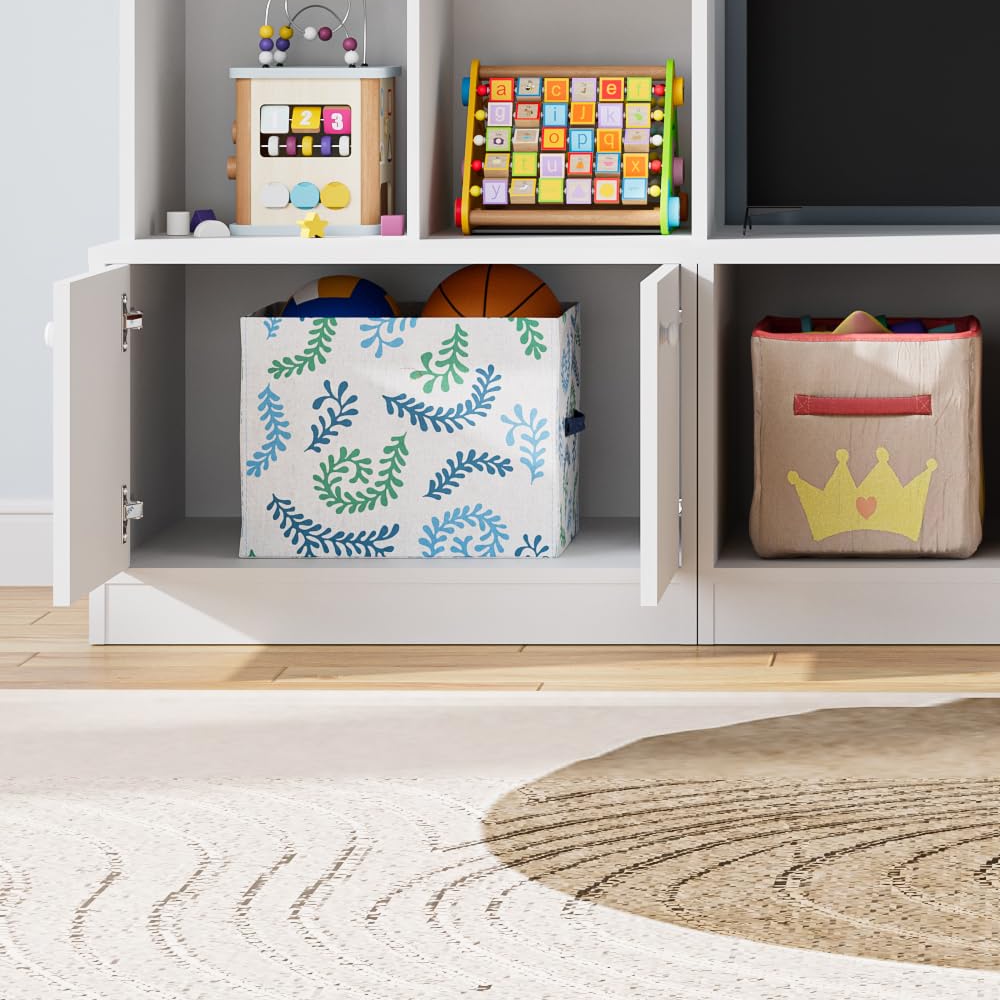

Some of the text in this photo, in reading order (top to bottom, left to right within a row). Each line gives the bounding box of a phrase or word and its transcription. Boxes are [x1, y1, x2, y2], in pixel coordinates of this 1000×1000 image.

[495, 84, 507, 96] a
[551, 85, 561, 97] c
[606, 83, 617, 95] e
[299, 110, 313, 126] 2
[330, 112, 344, 131] 3
[495, 105, 505, 121] g
[606, 107, 617, 121] k
[549, 132, 615, 149] o p q
[547, 161, 557, 171] u
[631, 160, 640, 172] x
[491, 185, 501, 200] y
